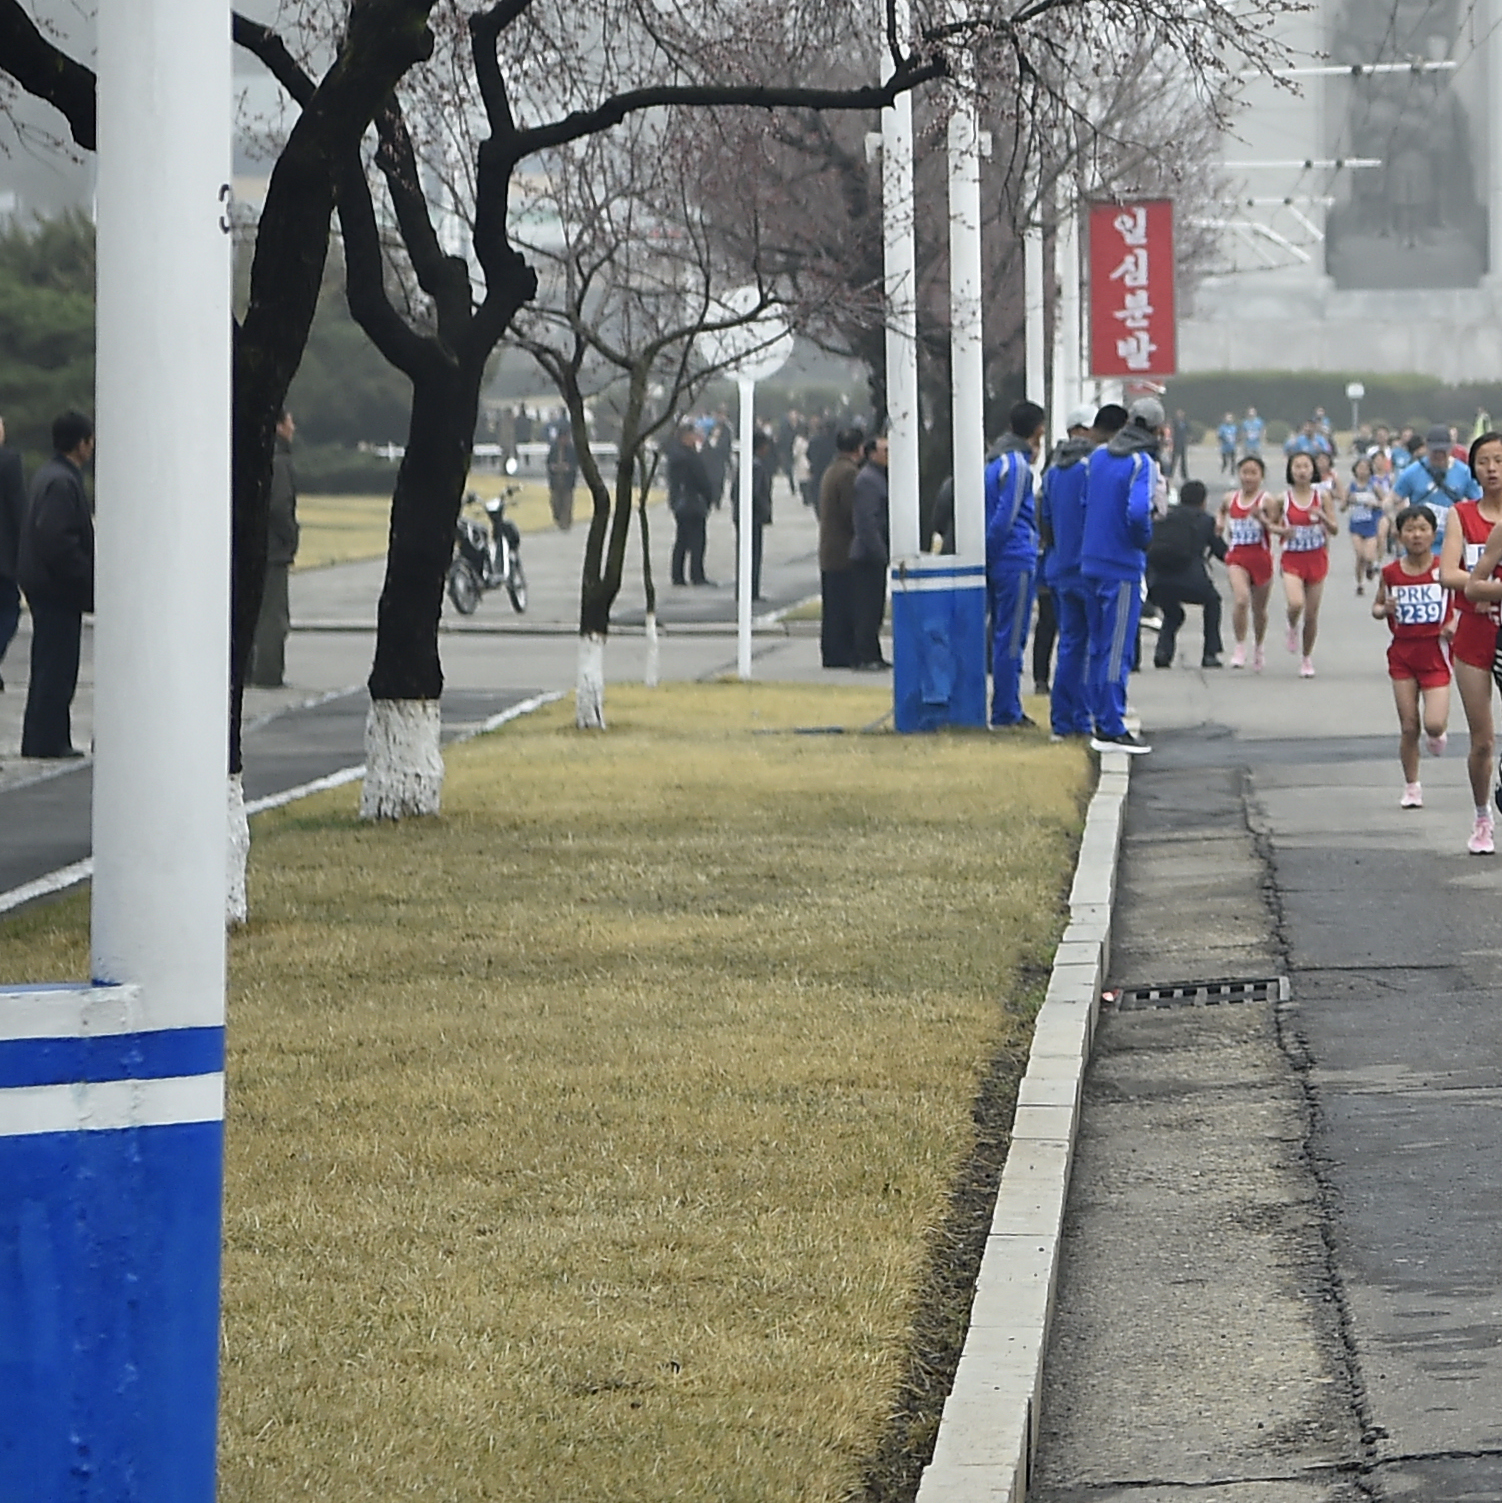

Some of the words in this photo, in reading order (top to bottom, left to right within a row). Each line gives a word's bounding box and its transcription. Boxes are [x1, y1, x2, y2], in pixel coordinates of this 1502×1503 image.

[1109, 206, 1157, 371] 일심분발
[1397, 586, 1433, 602] PRK
[1395, 603, 1440, 624] 3239
